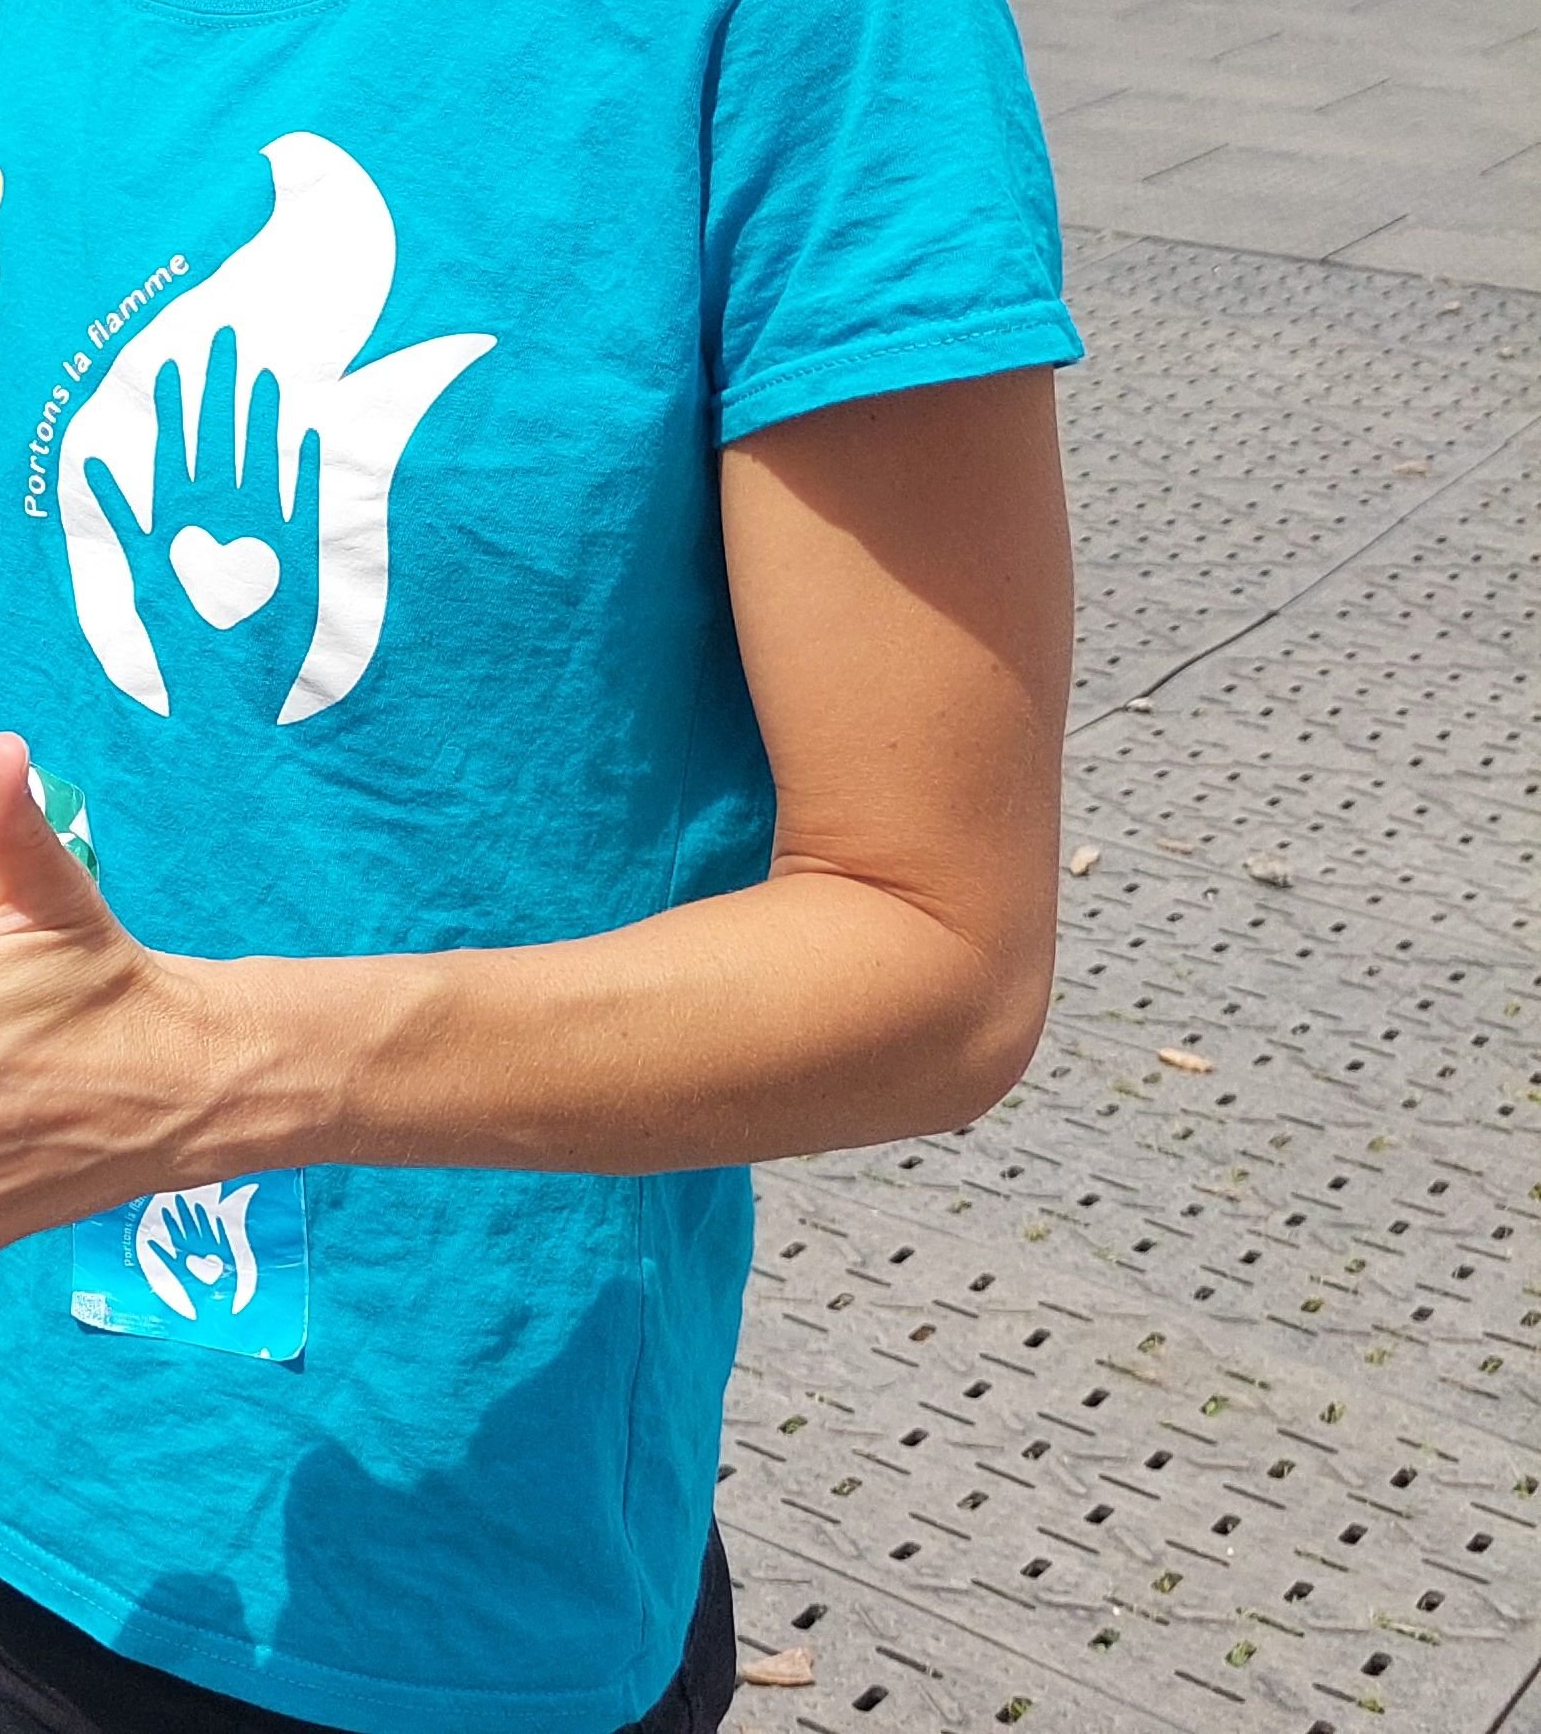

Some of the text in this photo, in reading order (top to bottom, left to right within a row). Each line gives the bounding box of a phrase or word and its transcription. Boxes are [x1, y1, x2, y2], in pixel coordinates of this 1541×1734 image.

[24, 254, 190, 517] Portons la flamme
